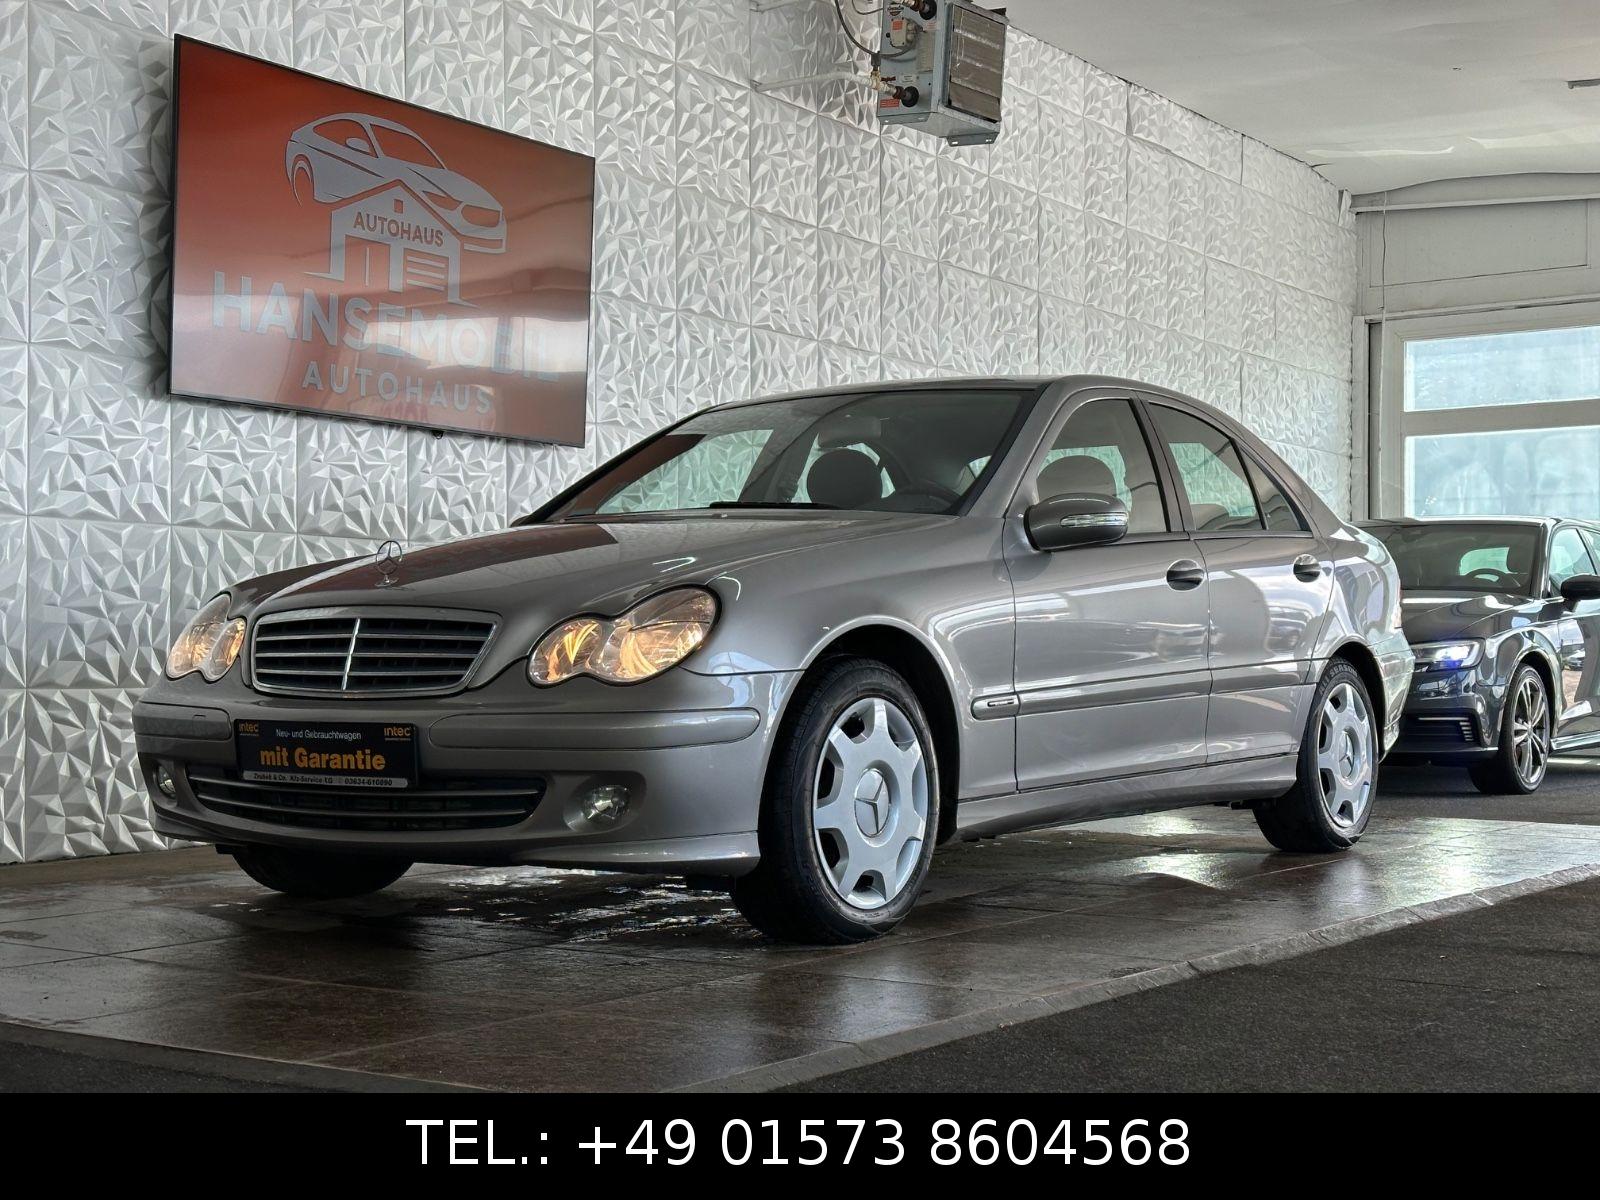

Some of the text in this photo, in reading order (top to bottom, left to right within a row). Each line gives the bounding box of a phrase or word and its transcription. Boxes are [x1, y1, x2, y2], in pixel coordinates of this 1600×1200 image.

[353, 210, 444, 248] AUTOHAUS
[302, 359, 493, 414] AUTOHAUS
[239, 721, 260, 733] intec
[276, 728, 362, 742] Neu- und Gebrauchtwagen
[383, 725, 412, 737] intec
[259, 745, 386, 770] mit Garantie
